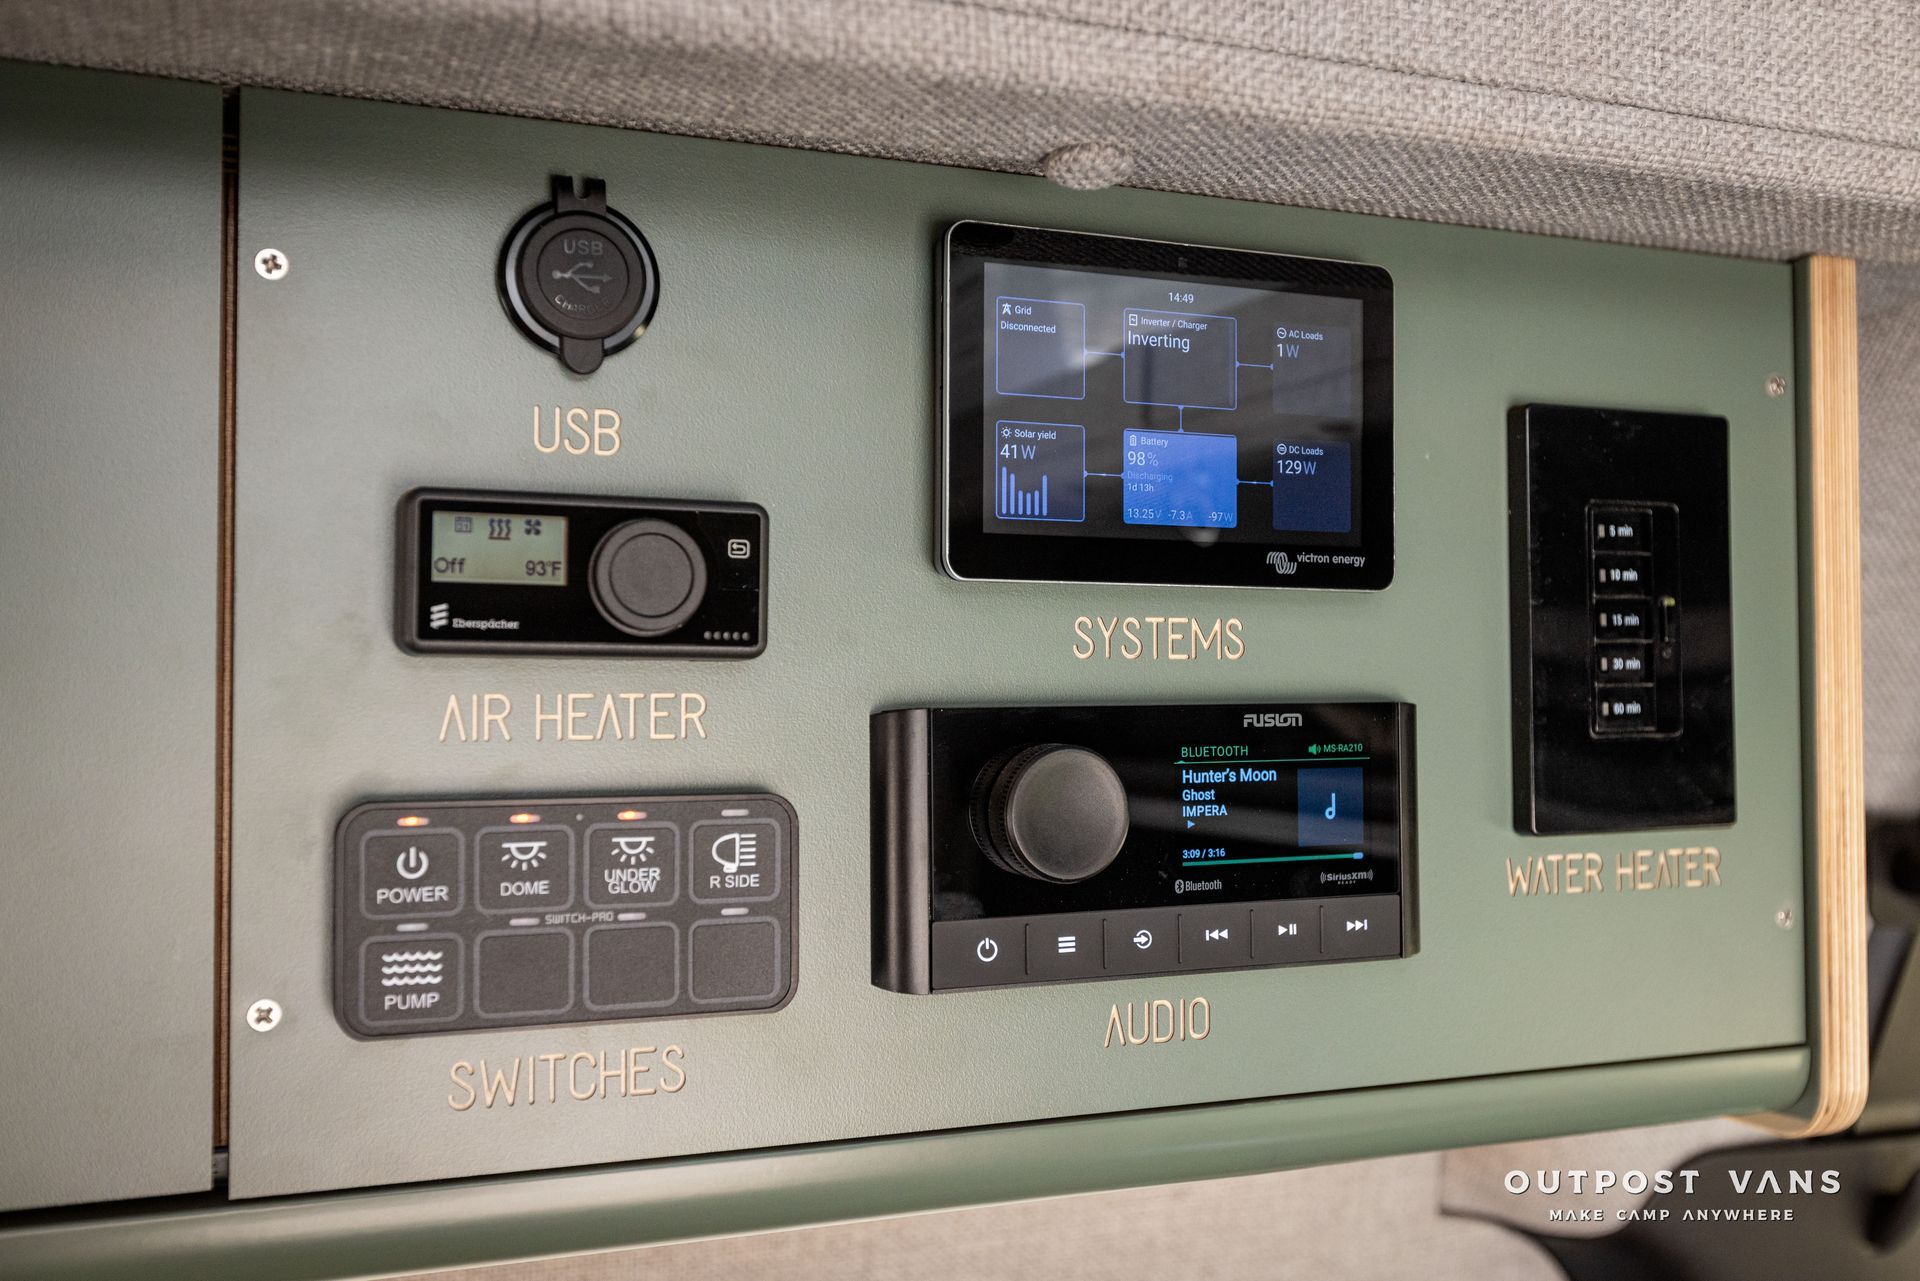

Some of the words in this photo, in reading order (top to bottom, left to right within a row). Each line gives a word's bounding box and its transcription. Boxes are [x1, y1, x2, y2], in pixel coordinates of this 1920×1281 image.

[564, 239, 604, 256] USB
[1168, 292, 1194, 304] 14:49
[1014, 305, 1032, 315] Grid
[1000, 321, 1057, 334] Disconnected
[1141, 317, 1170, 328] Inverter
[1177, 320, 1208, 331] Charger
[1127, 331, 1190, 352] Inverting
[1288, 331, 1300, 339] AC
[1301, 331, 1323, 341] Loads
[533, 404, 622, 456] USB
[1014, 428, 1036, 439] Solar
[1037, 430, 1057, 440] yield
[1140, 437, 1169, 448] Battery
[1288, 445, 1300, 454] DC
[1301, 446, 1324, 456] Loads
[1127, 471, 1173, 482] Discharging
[1128, 483, 1138, 491] 1d
[1140, 483, 1154, 492] 13h
[1609, 524, 1616, 537] 5
[1617, 523, 1633, 537] min
[434, 557, 466, 573] Off
[1297, 552, 1330, 564] victron
[1332, 554, 1366, 567] energy
[1610, 568, 1621, 581] 10
[1622, 568, 1638, 582] min
[1612, 613, 1623, 626] 15
[1624, 612, 1640, 626] min
[1072, 616, 1246, 660] SYSTEMS
[1612, 657, 1624, 670] 30
[1625, 656, 1641, 670] min
[1613, 702, 1624, 715] 60
[1626, 701, 1641, 714] min
[439, 693, 512, 742] AIR
[535, 692, 708, 741] HEATER
[1243, 713, 1303, 728] FUSION
[1181, 745, 1249, 758] BLUETOOTH
[1323, 743, 1363, 753] MS-RA210
[1239, 768, 1278, 782] Moon
[1182, 789, 1216, 802] Ghost
[1182, 804, 1228, 818] IMPERA
[1182, 849, 1201, 859] 3:09
[1207, 848, 1226, 858] 3:16
[604, 867, 661, 882] UNDER
[1505, 852, 1604, 897] WATER
[1615, 846, 1722, 892] HEATER
[608, 879, 657, 894] GLOW
[709, 875, 721, 889] R
[724, 873, 760, 889] SIDE
[1185, 879, 1222, 892] Bluetooth
[376, 885, 449, 905] POWER
[500, 880, 550, 897] DOME
[544, 911, 614, 925] SWITCH-PRO
[384, 992, 440, 1010] PUMP
[1104, 996, 1211, 1049] AUDIO
[447, 1044, 687, 1111] SWITCHES
